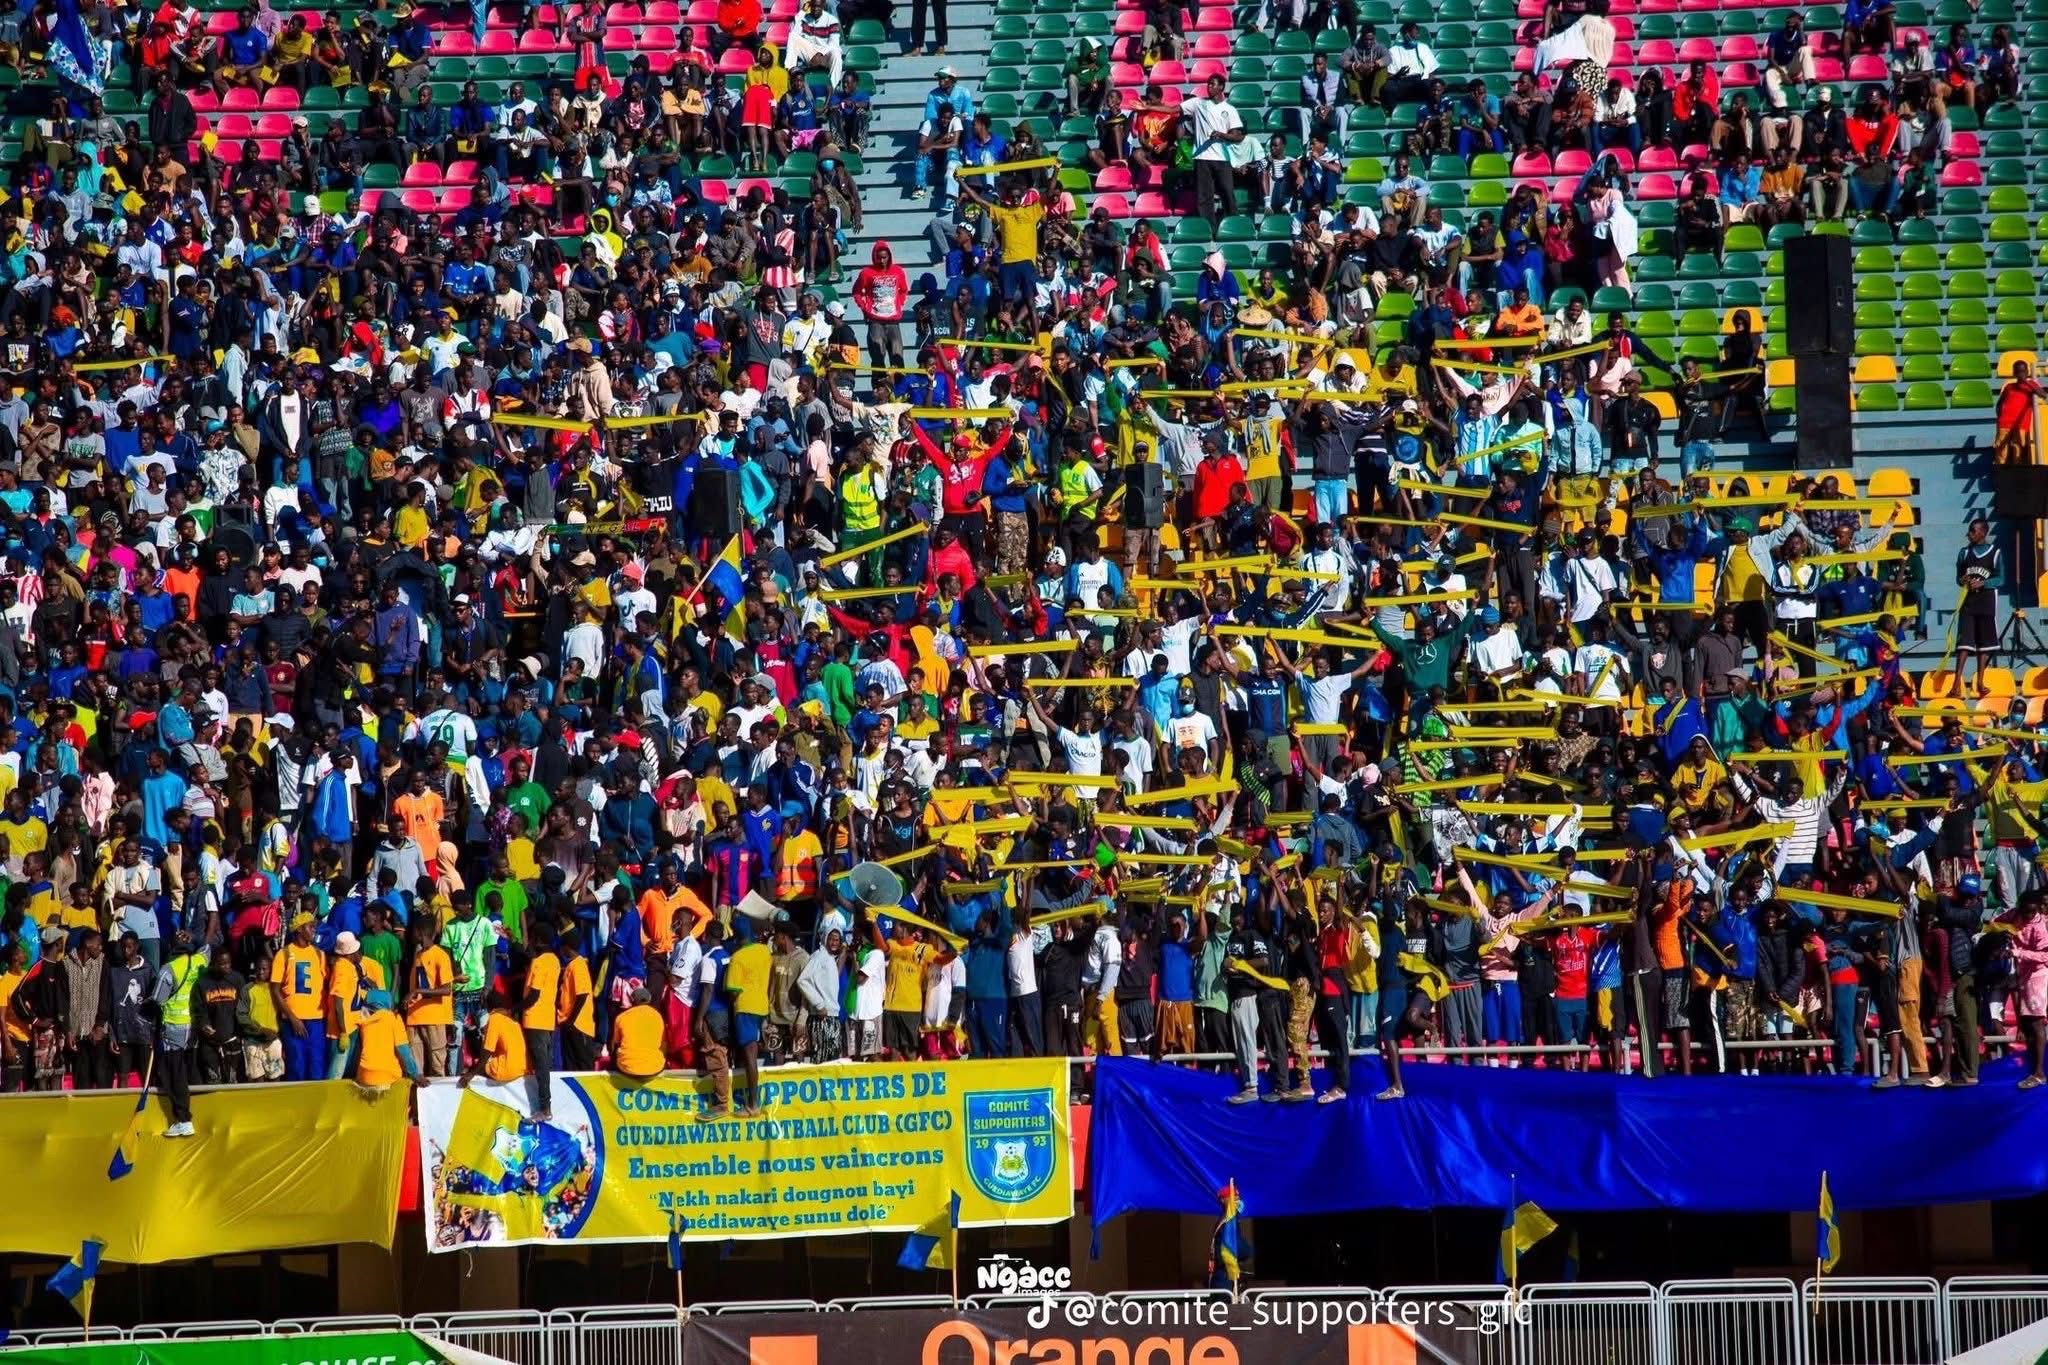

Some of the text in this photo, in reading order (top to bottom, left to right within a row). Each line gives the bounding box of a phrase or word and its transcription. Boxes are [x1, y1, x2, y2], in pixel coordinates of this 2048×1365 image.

[295, 961, 312, 994] E
[911, 1072, 946, 1098] DE
[988, 1099, 1030, 1113] COMITÉ
[616, 1110, 952, 1146] GUEDIAWAYE FOOTBALL CLUB (GFC)
[974, 1115, 1046, 1130] SUPPORTERS
[975, 1135, 1047, 1149] 19 93
[629, 1147, 944, 1179] Ensemble nous vaincrons
[716, 1187, 778, 1206] nakari
[783, 1186, 867, 1204] dougnou
[873, 1179, 915, 1199] bayi
[794, 1211, 841, 1226] sunu
